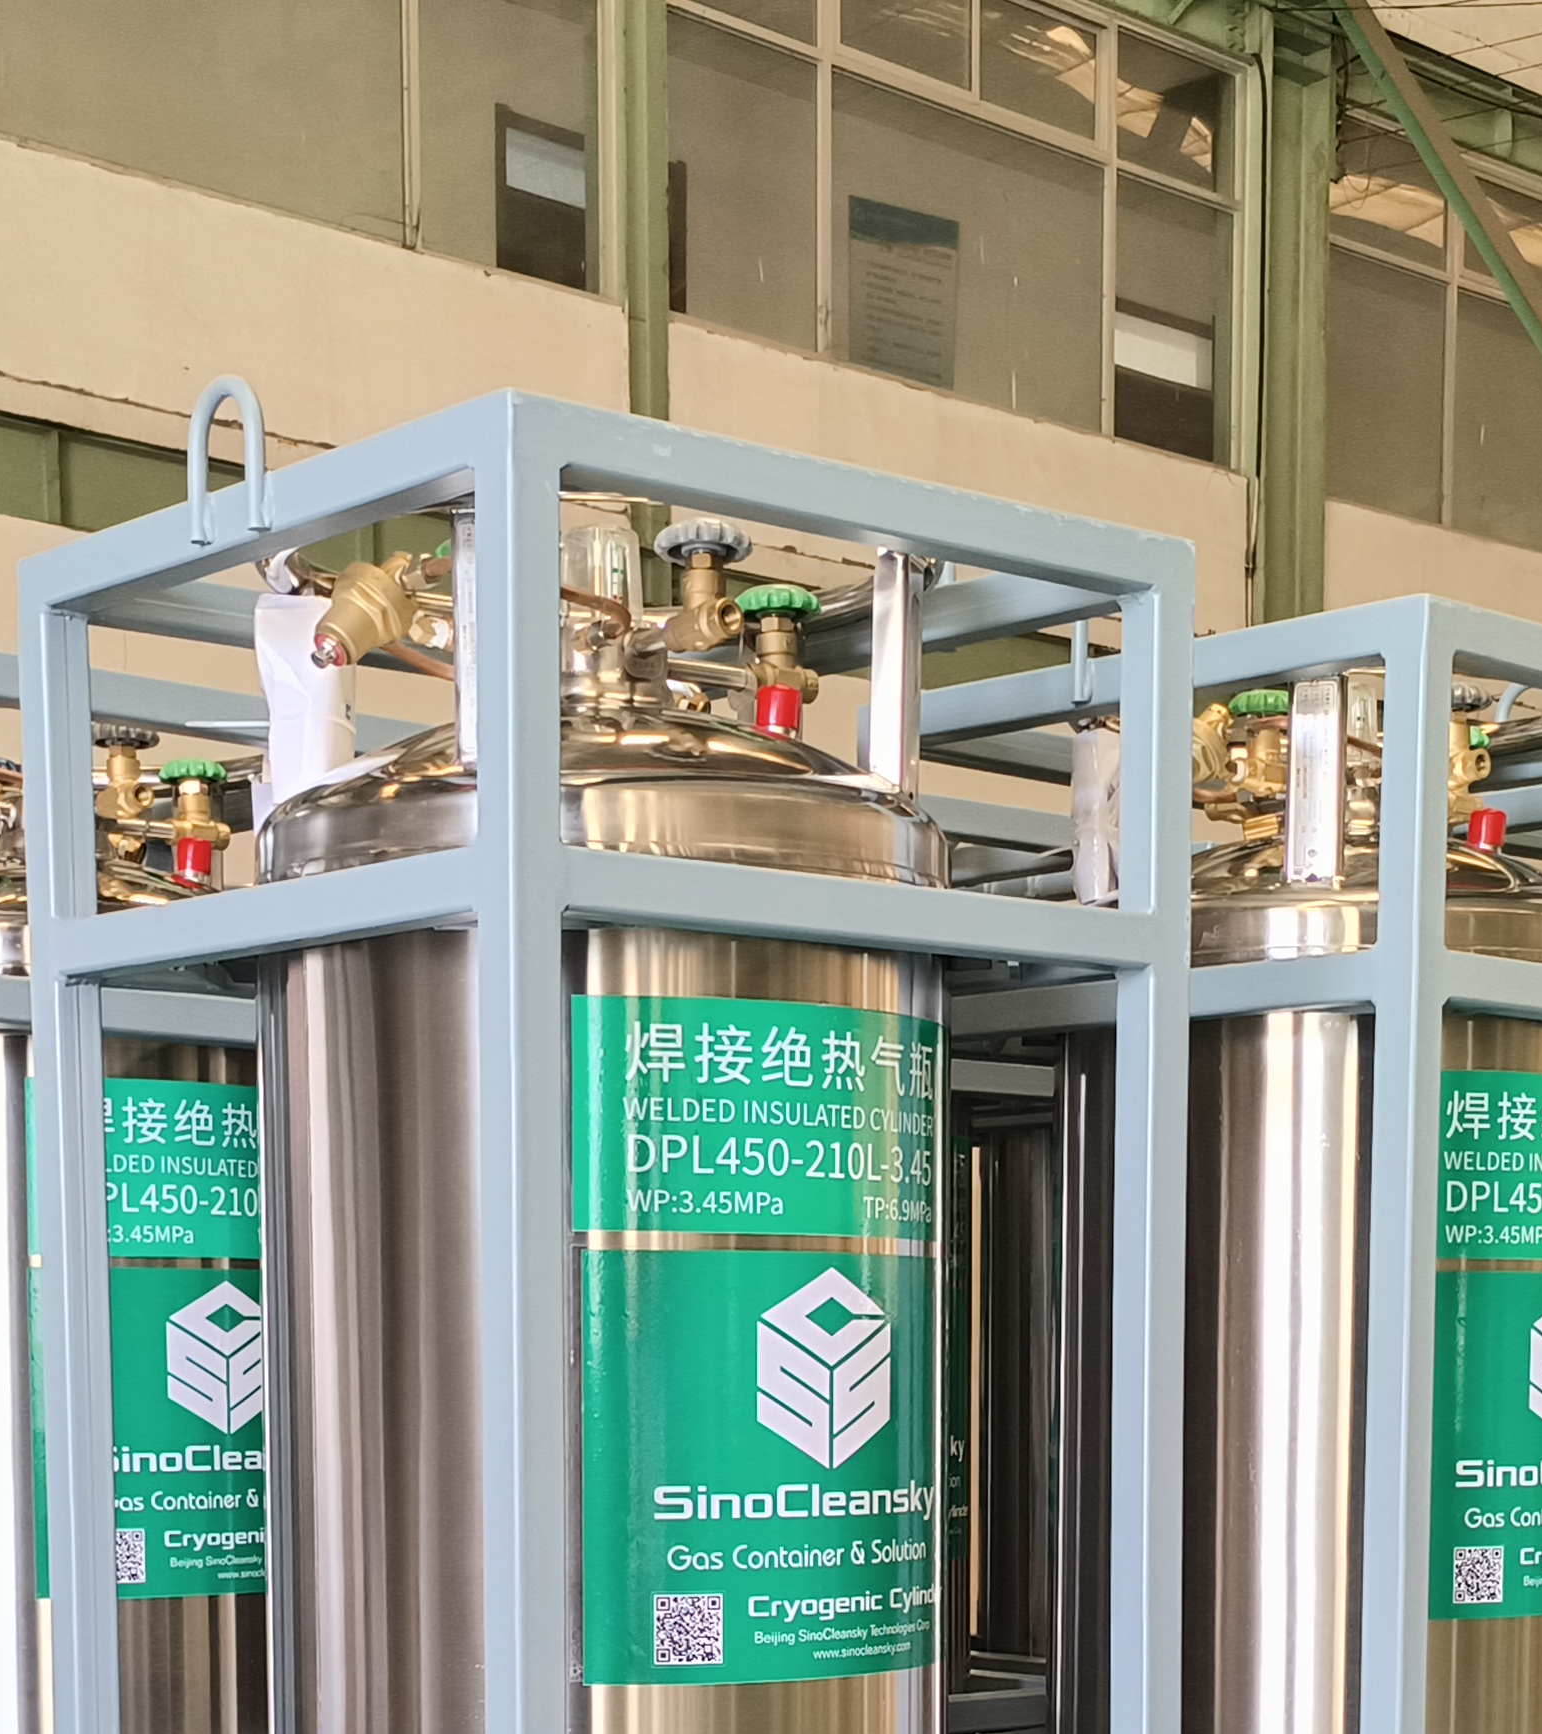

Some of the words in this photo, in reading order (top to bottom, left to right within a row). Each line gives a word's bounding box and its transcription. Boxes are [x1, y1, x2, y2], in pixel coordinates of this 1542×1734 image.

[624, 1020, 933, 1100] 焊接绝热气瓶
[623, 1096, 736, 1123] WELDED
[743, 1099, 865, 1130] INSULATED
[870, 1106, 933, 1138] CYLINDER
[161, 1156, 258, 1179] INSULATED
[626, 1133, 931, 1187] DPL450-210L-3.45
[1443, 1151, 1524, 1172] WELDED
[627, 1189, 784, 1216] WP:3.45MPa
[863, 1196, 932, 1223] TP:6.9MPa
[151, 1490, 241, 1512] Container
[246, 1489, 259, 1508] &
[654, 1480, 935, 1521] SinoCleansky
[1464, 1507, 1505, 1529] Gas
[667, 1545, 724, 1571] Gas
[733, 1542, 843, 1569] Container
[851, 1541, 865, 1565] &
[871, 1538, 926, 1564] Solution
[748, 1590, 883, 1623] Cryogenic
[754, 1631, 795, 1646] Beijing
[798, 1626, 868, 1642] SinoCleansky
